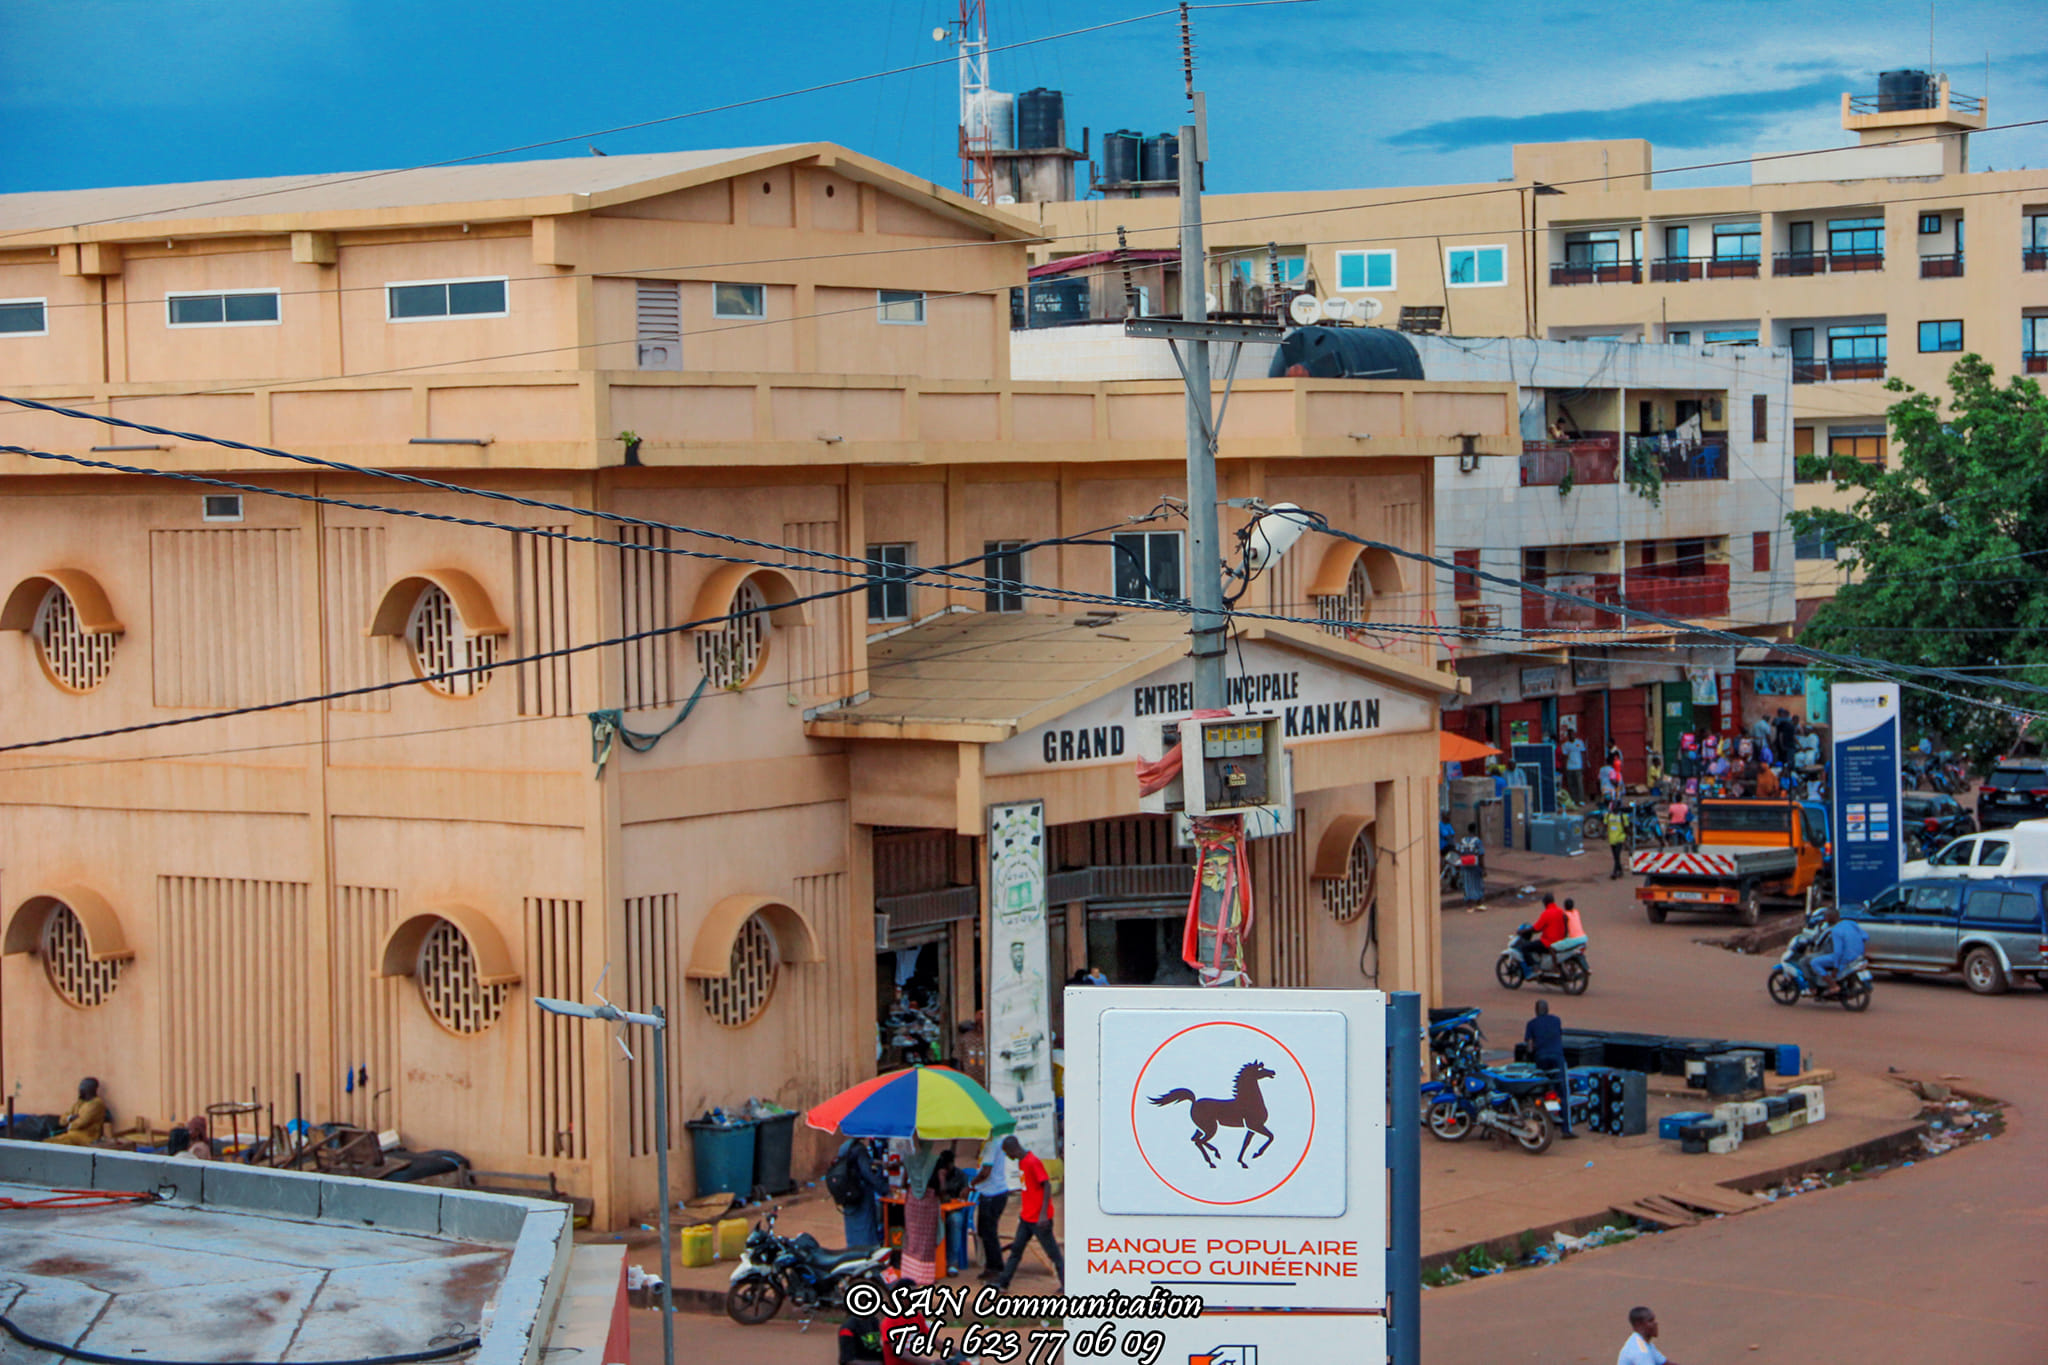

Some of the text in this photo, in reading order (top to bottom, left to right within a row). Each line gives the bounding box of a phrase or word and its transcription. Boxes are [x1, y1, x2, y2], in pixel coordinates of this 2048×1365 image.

[1134, 671, 1299, 717] ENTRE INCIPALE
[1042, 698, 1380, 763] GRAND KANKAN
[1087, 1238, 1358, 1256] BANQUE POPULAIRE
[1087, 1257, 1358, 1277] MAROCO GUINÉENNE
